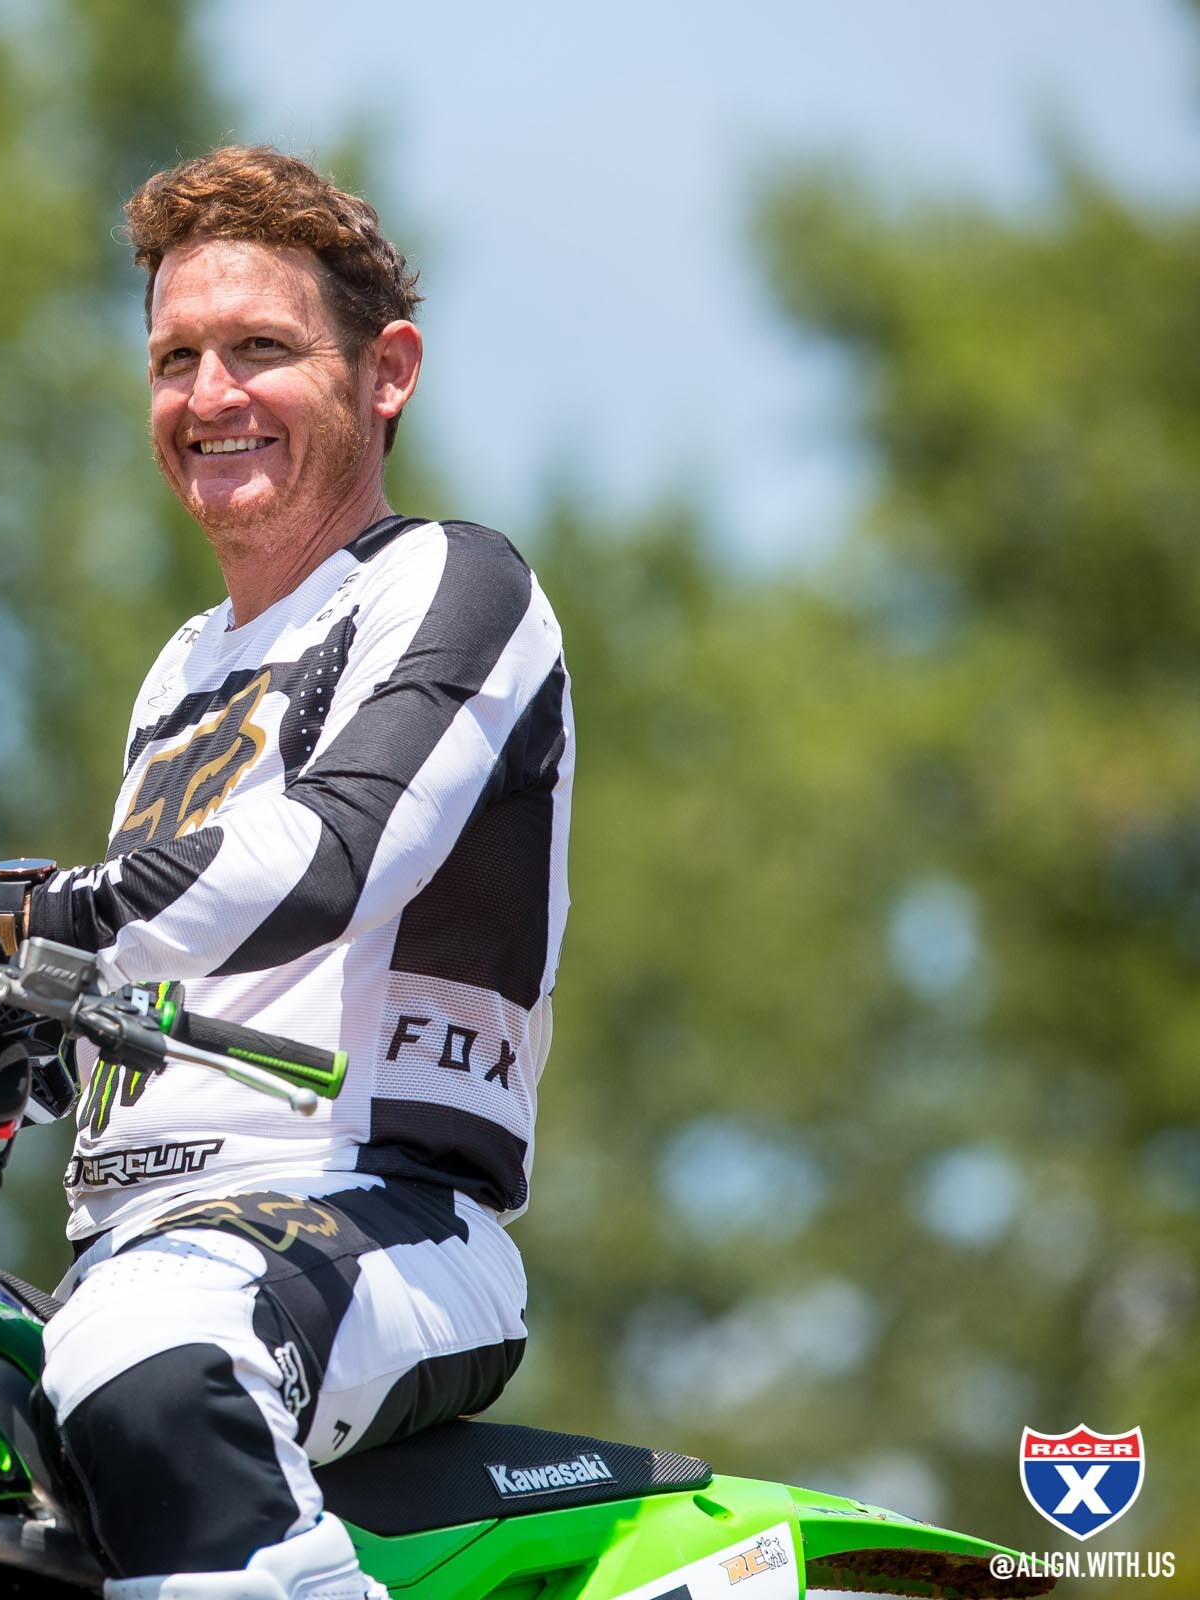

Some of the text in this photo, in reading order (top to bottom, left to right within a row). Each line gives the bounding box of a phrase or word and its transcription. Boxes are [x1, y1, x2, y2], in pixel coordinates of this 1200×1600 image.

[386, 1015, 517, 1091] FOX
[83, 1142, 218, 1183] CIRCUIT
[487, 1454, 613, 1493] Kawasaki
